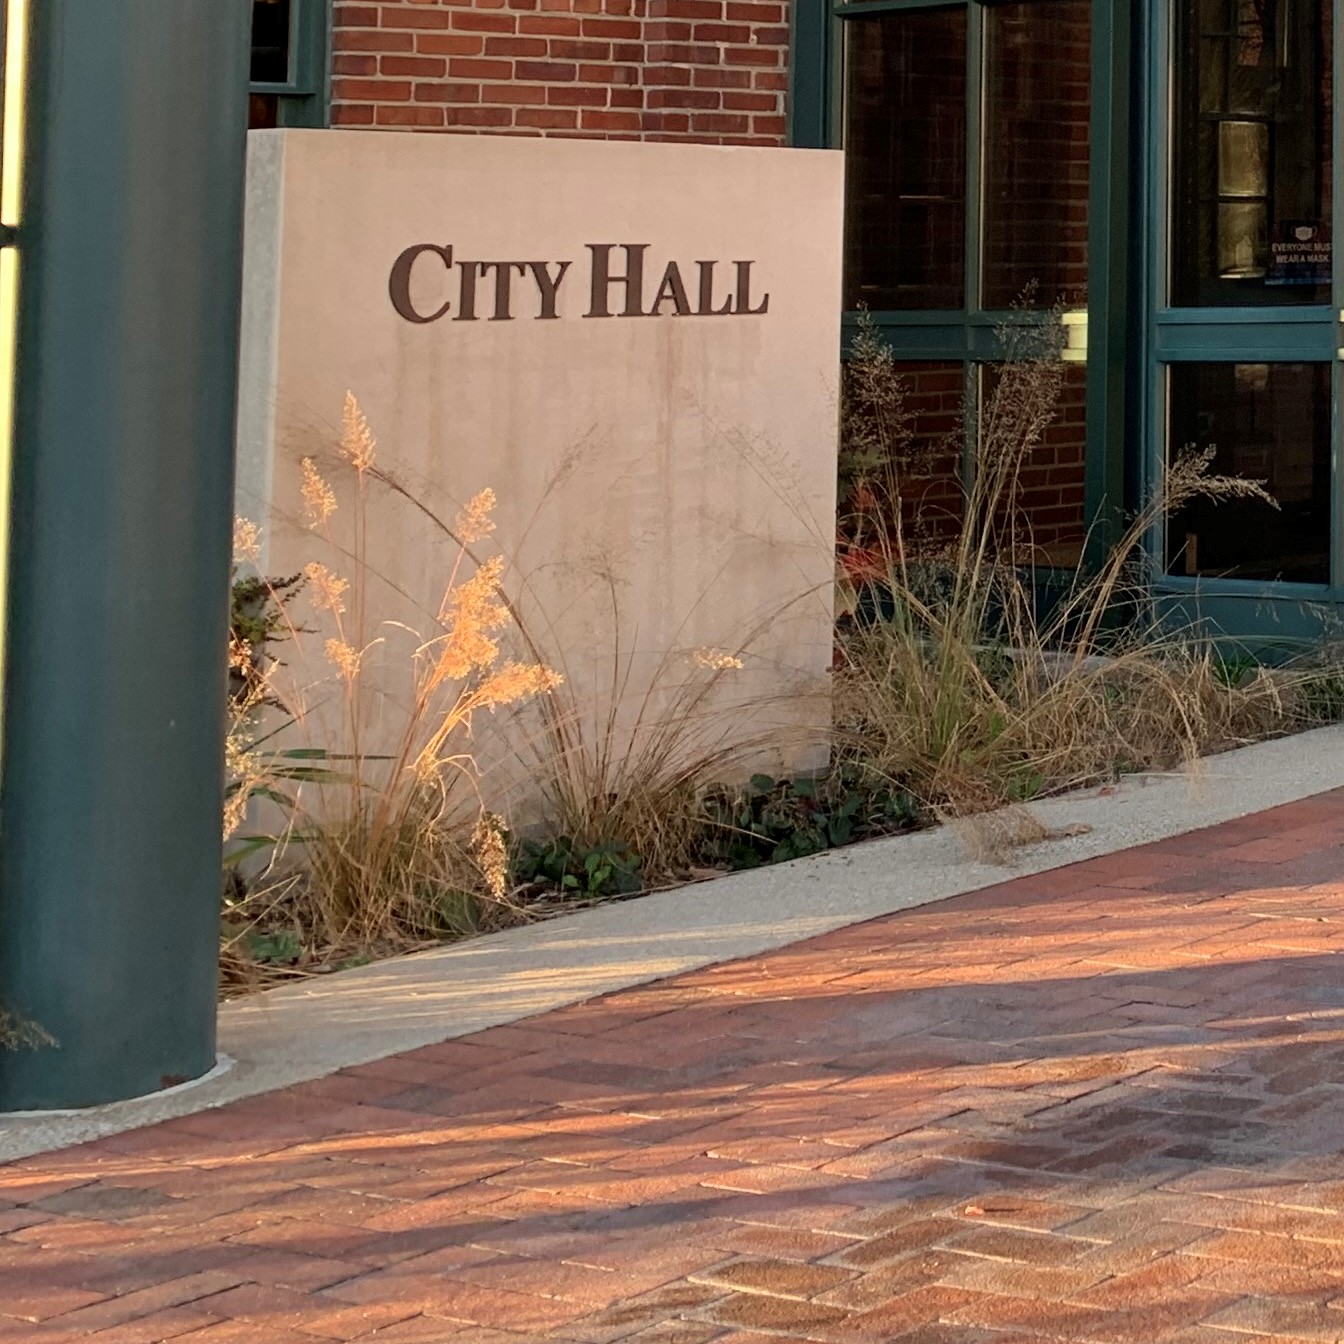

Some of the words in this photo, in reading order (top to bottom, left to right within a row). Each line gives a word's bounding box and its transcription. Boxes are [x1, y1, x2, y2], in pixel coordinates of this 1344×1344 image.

[1271, 242, 1313, 252] EVERYONE
[1276, 254, 1299, 263] WEAR
[1300, 254, 1306, 263] A
[1307, 254, 1329, 263] MASK
[388, 243, 573, 324] CITY
[581, 243, 770, 318] HALL
